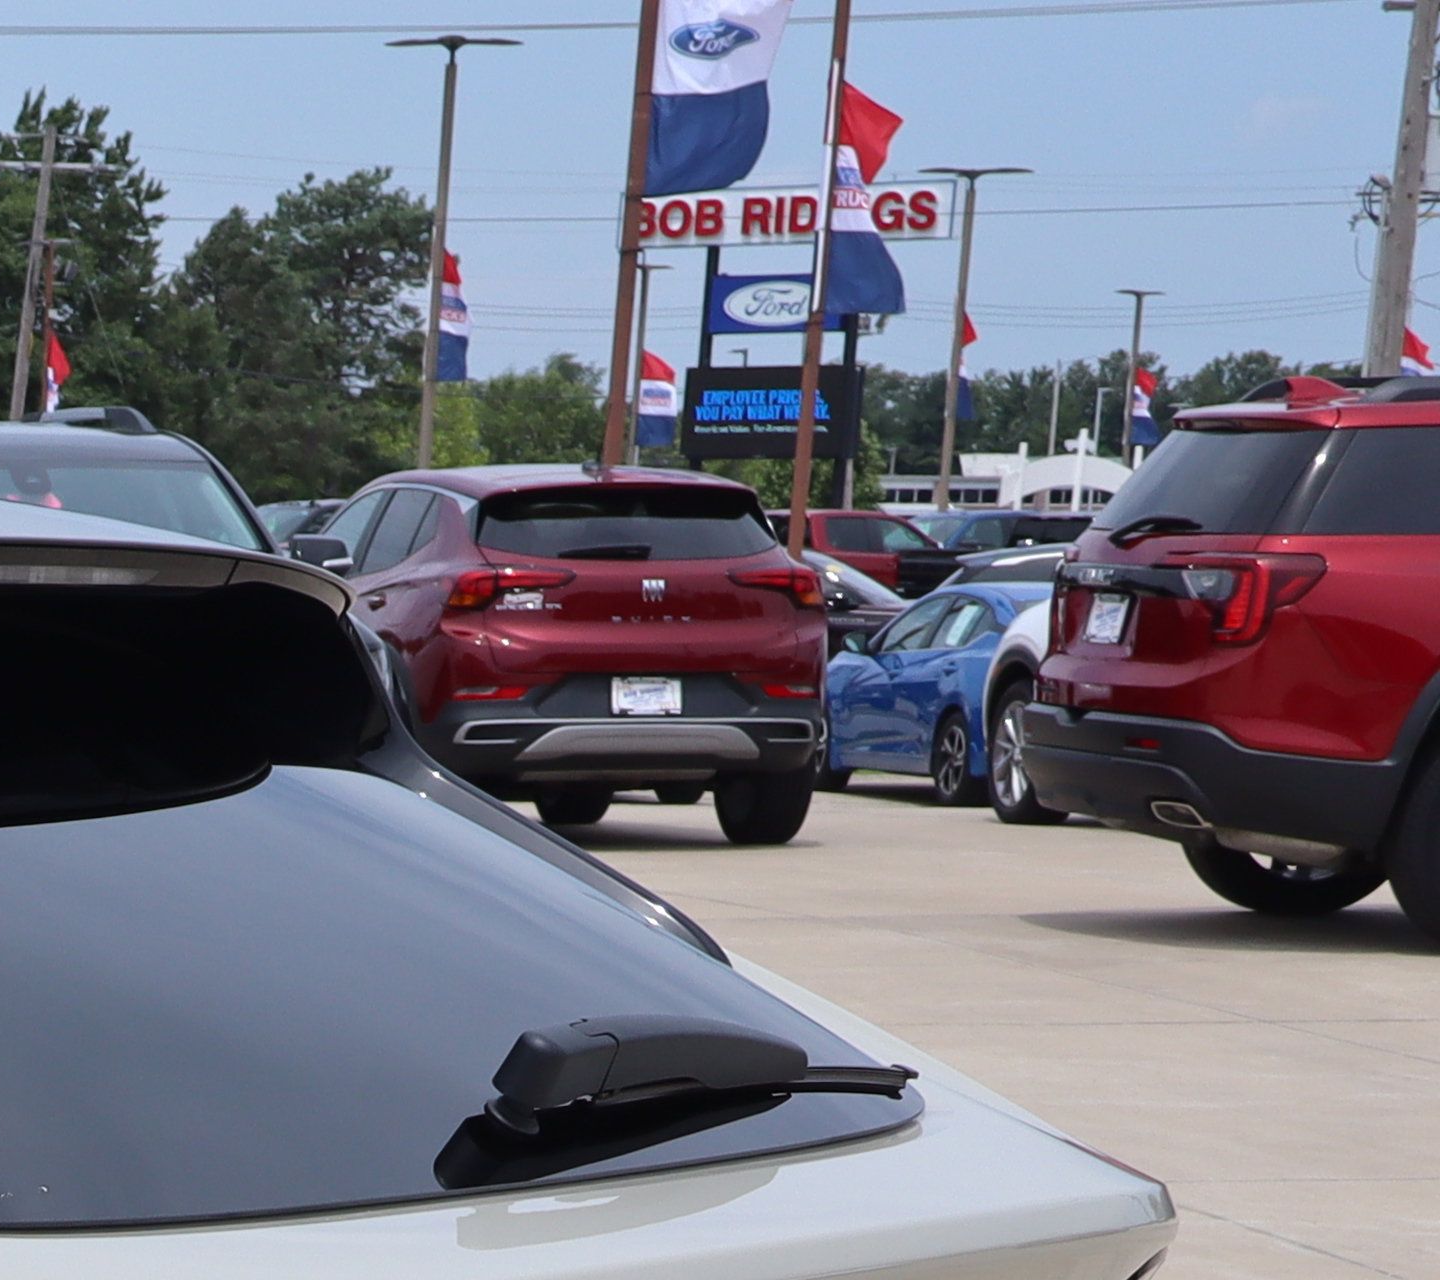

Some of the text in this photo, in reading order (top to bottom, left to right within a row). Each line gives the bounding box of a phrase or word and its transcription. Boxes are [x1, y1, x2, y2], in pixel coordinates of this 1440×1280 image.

[640, 191, 938, 238] BOB RIDGS
[744, 286, 806, 317] Ford
